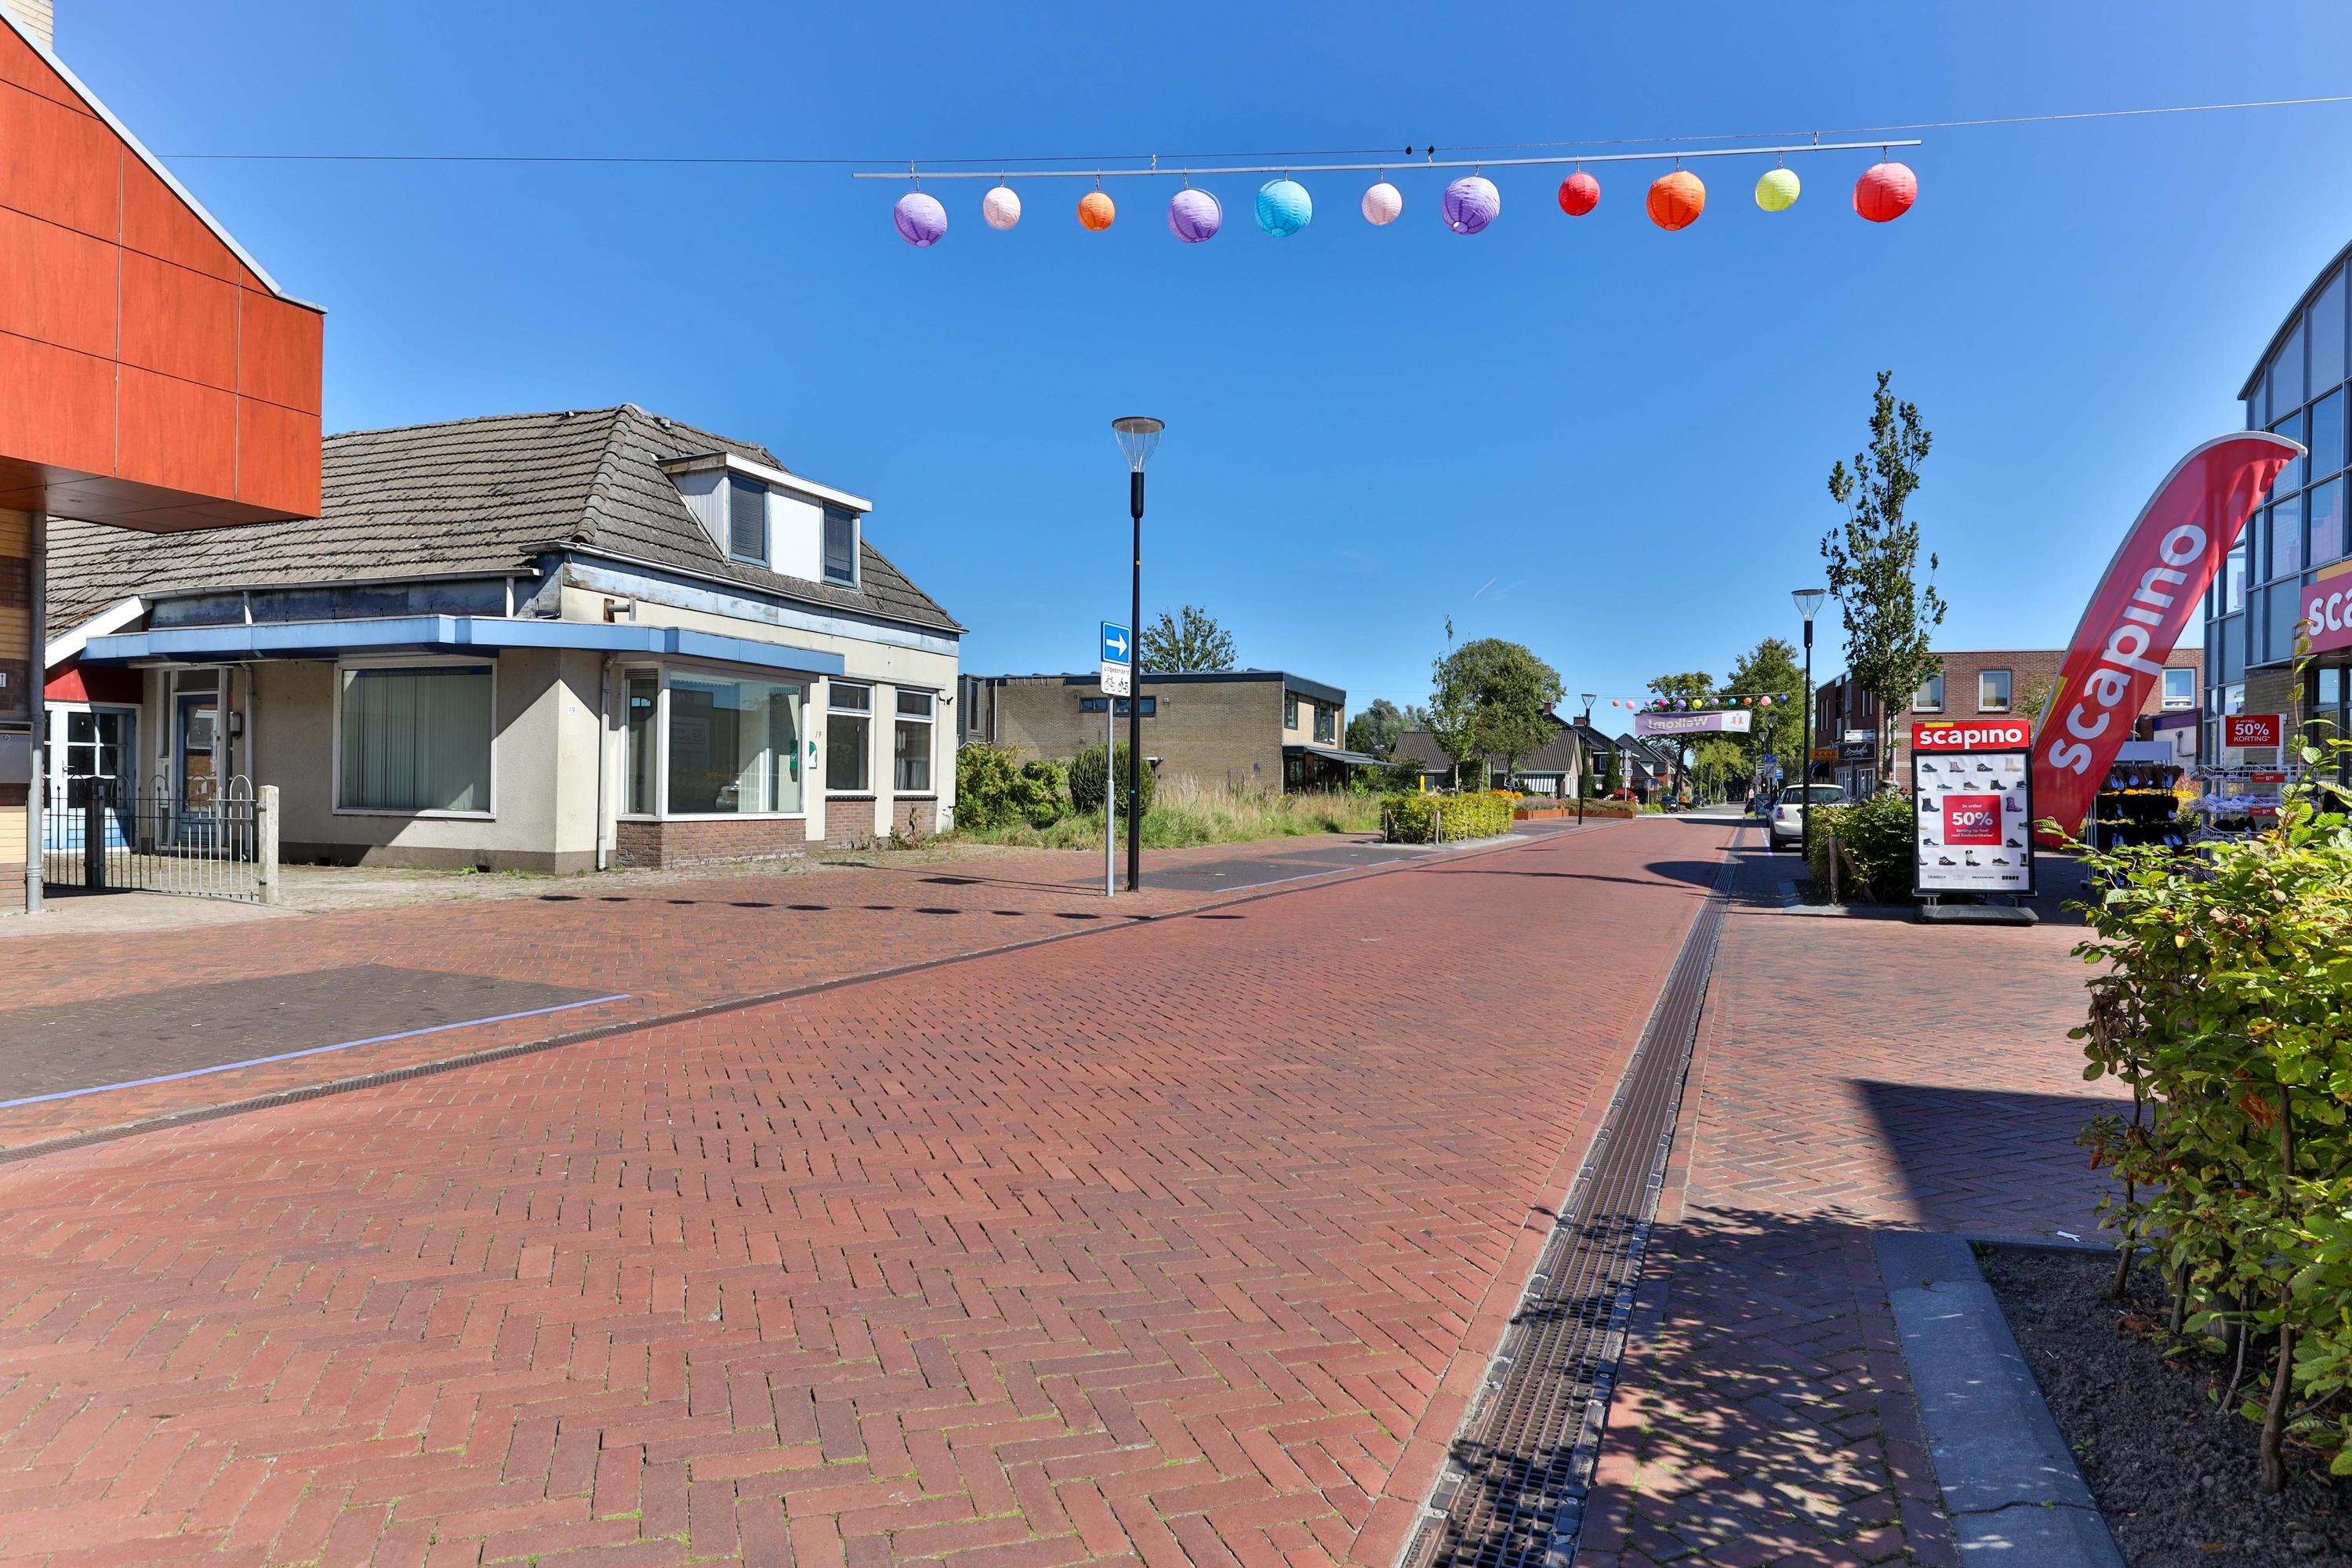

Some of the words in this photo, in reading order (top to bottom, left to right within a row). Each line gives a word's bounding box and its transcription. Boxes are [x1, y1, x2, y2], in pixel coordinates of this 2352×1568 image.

[2049, 524, 2207, 775] scapino
[1104, 666, 1130, 675] uitgezonderd
[815, 730, 822, 739] 19
[2235, 723, 2269, 735] 50%
[1919, 728, 2023, 750] scapino
[1951, 811, 1994, 826] 50%
